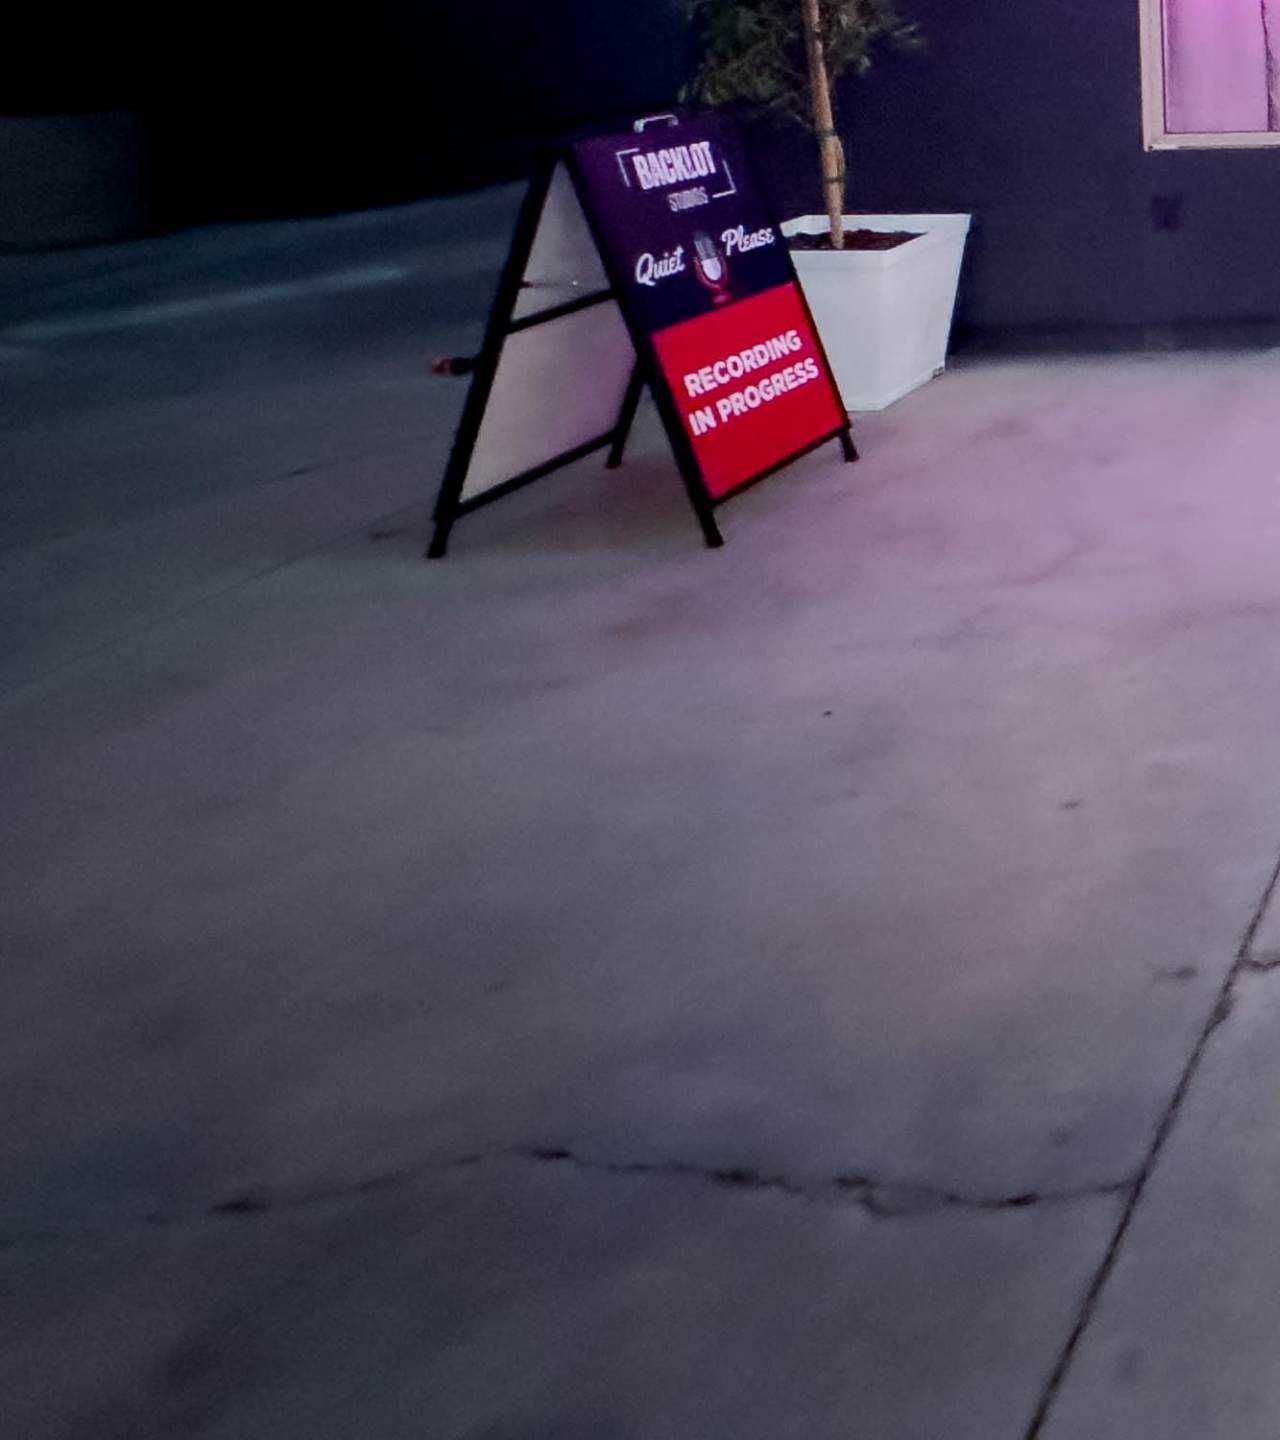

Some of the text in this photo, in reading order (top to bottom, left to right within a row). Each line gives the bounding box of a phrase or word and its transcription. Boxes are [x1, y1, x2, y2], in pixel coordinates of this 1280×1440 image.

[632, 141, 717, 191] BACKLOT
[635, 224, 775, 287] Quiet Please
[684, 329, 803, 398] RECORDING
[688, 357, 819, 437] IN PROGRESS
